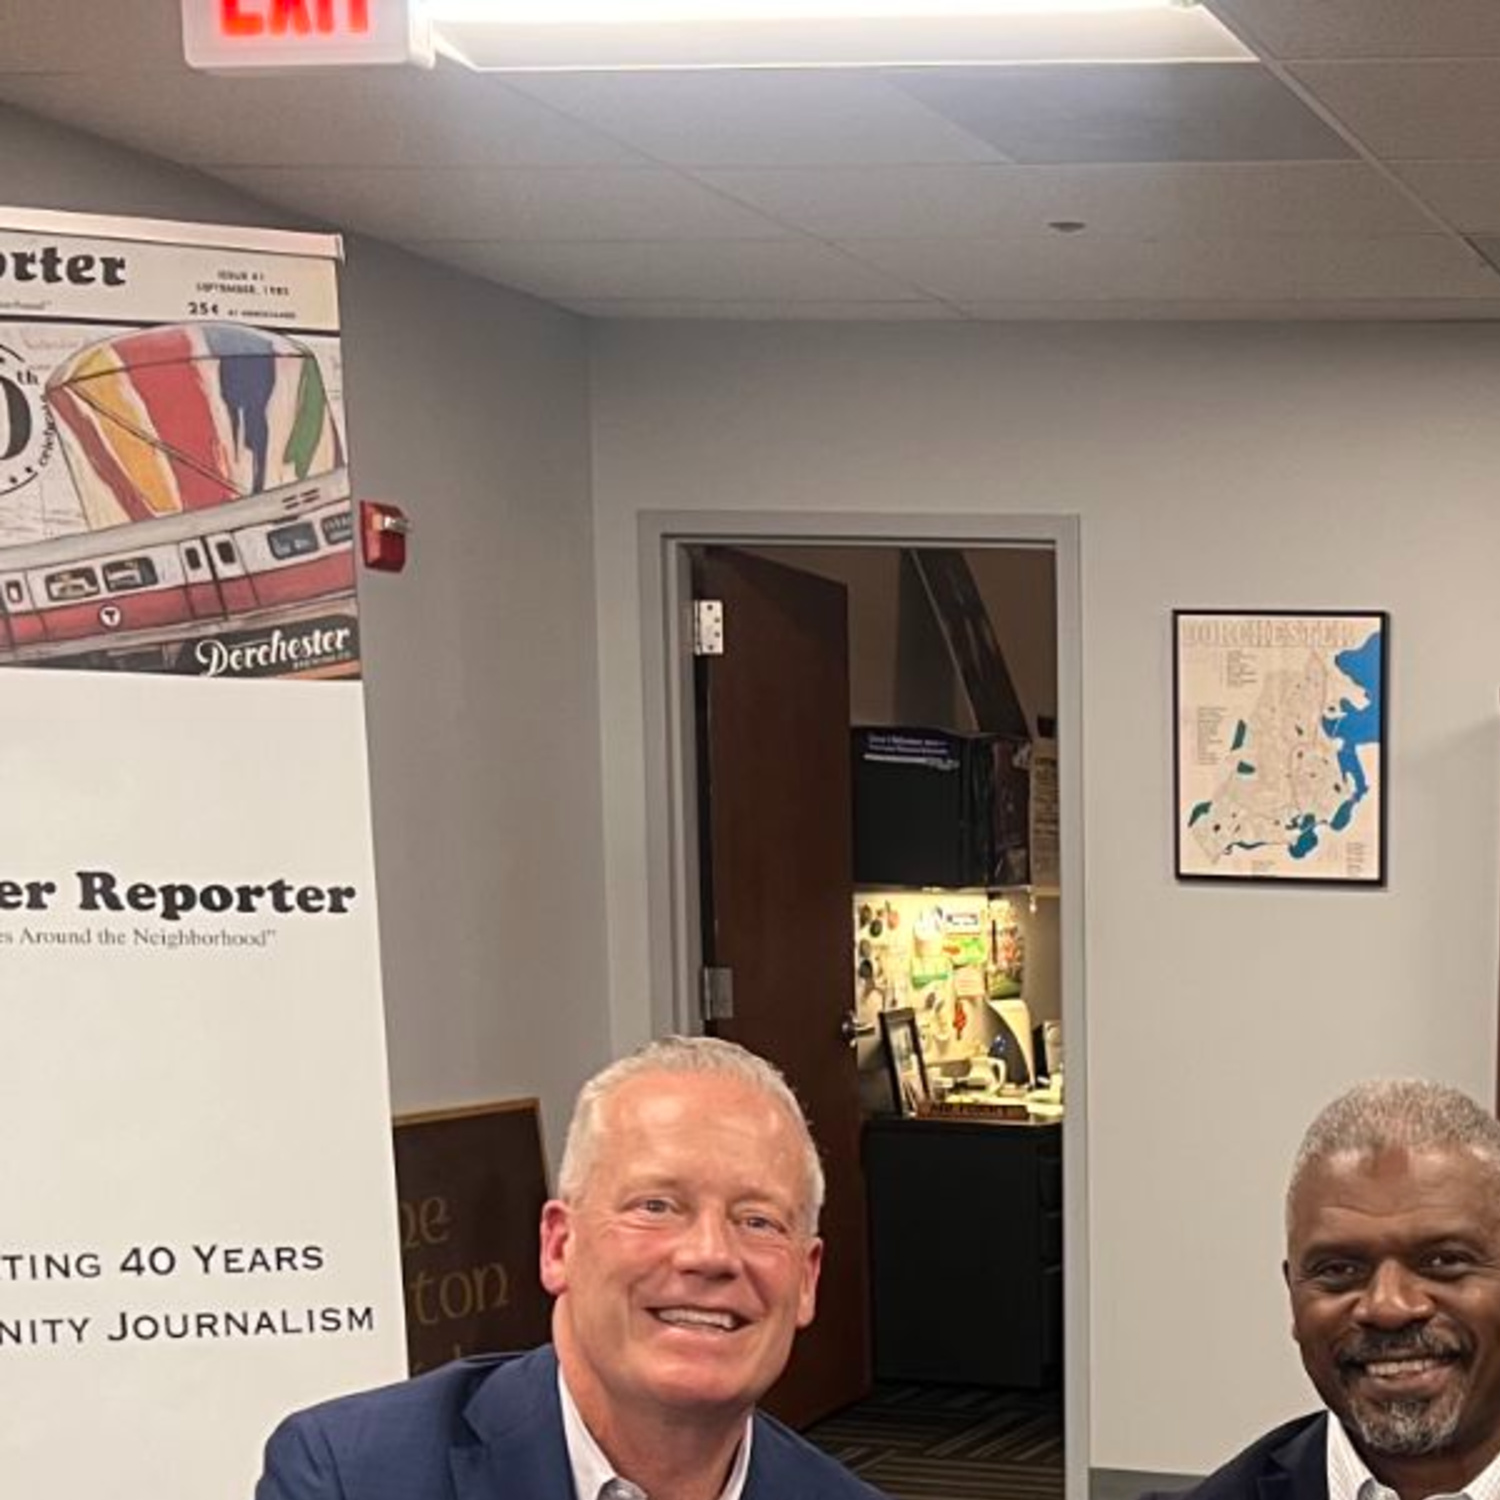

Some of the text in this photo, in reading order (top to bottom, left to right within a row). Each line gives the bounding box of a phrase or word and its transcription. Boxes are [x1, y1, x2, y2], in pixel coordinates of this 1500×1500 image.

[0, 247, 126, 286] rter
[75, 871, 356, 921] Reporter
[19, 928, 91, 945] Around
[98, 928, 126, 945] the
[1, 1244, 325, 1280] TING 40 YEARS
[0, 1307, 374, 1345] NITY JOURNALISM
